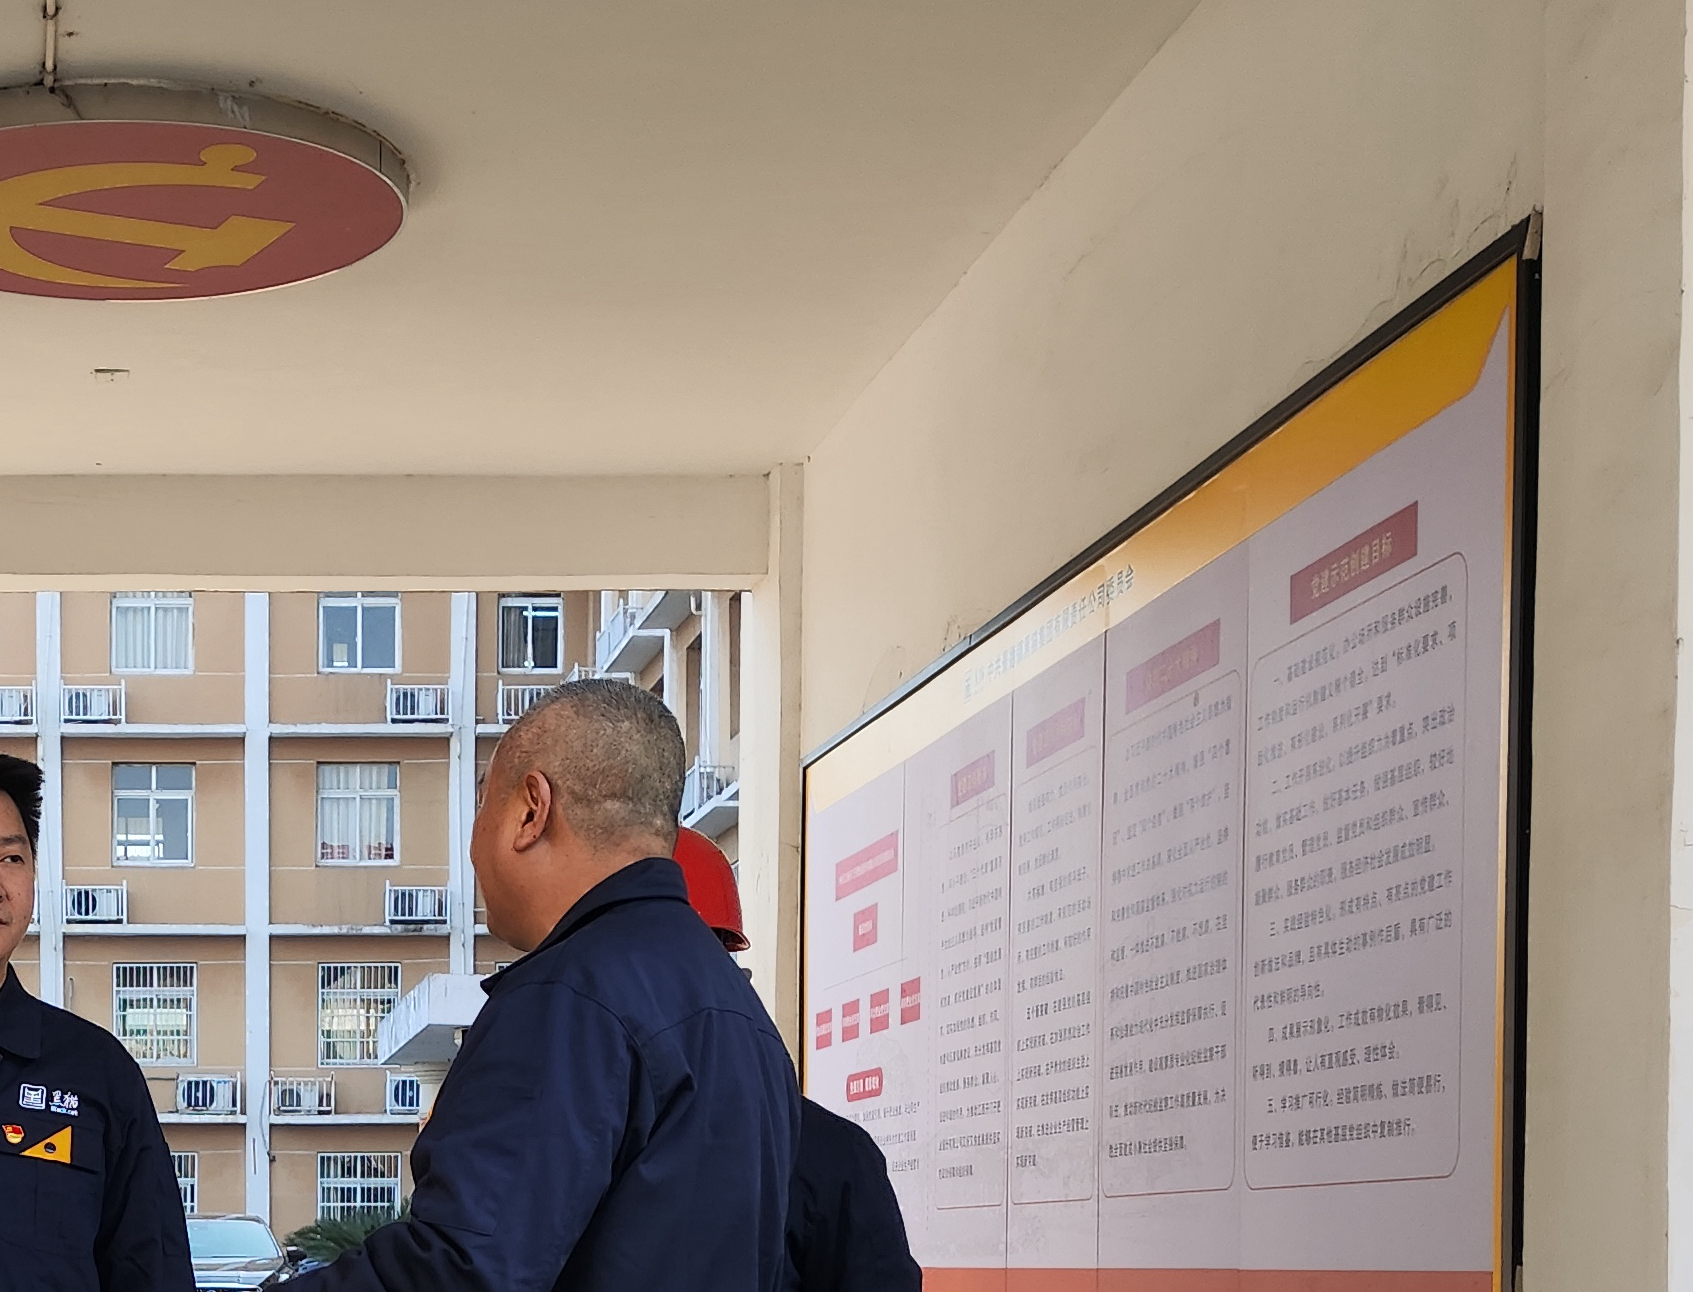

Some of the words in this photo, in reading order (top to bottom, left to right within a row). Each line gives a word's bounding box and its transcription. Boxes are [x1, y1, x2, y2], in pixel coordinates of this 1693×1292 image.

[1310, 531, 1393, 600] 党建示范创建目标
